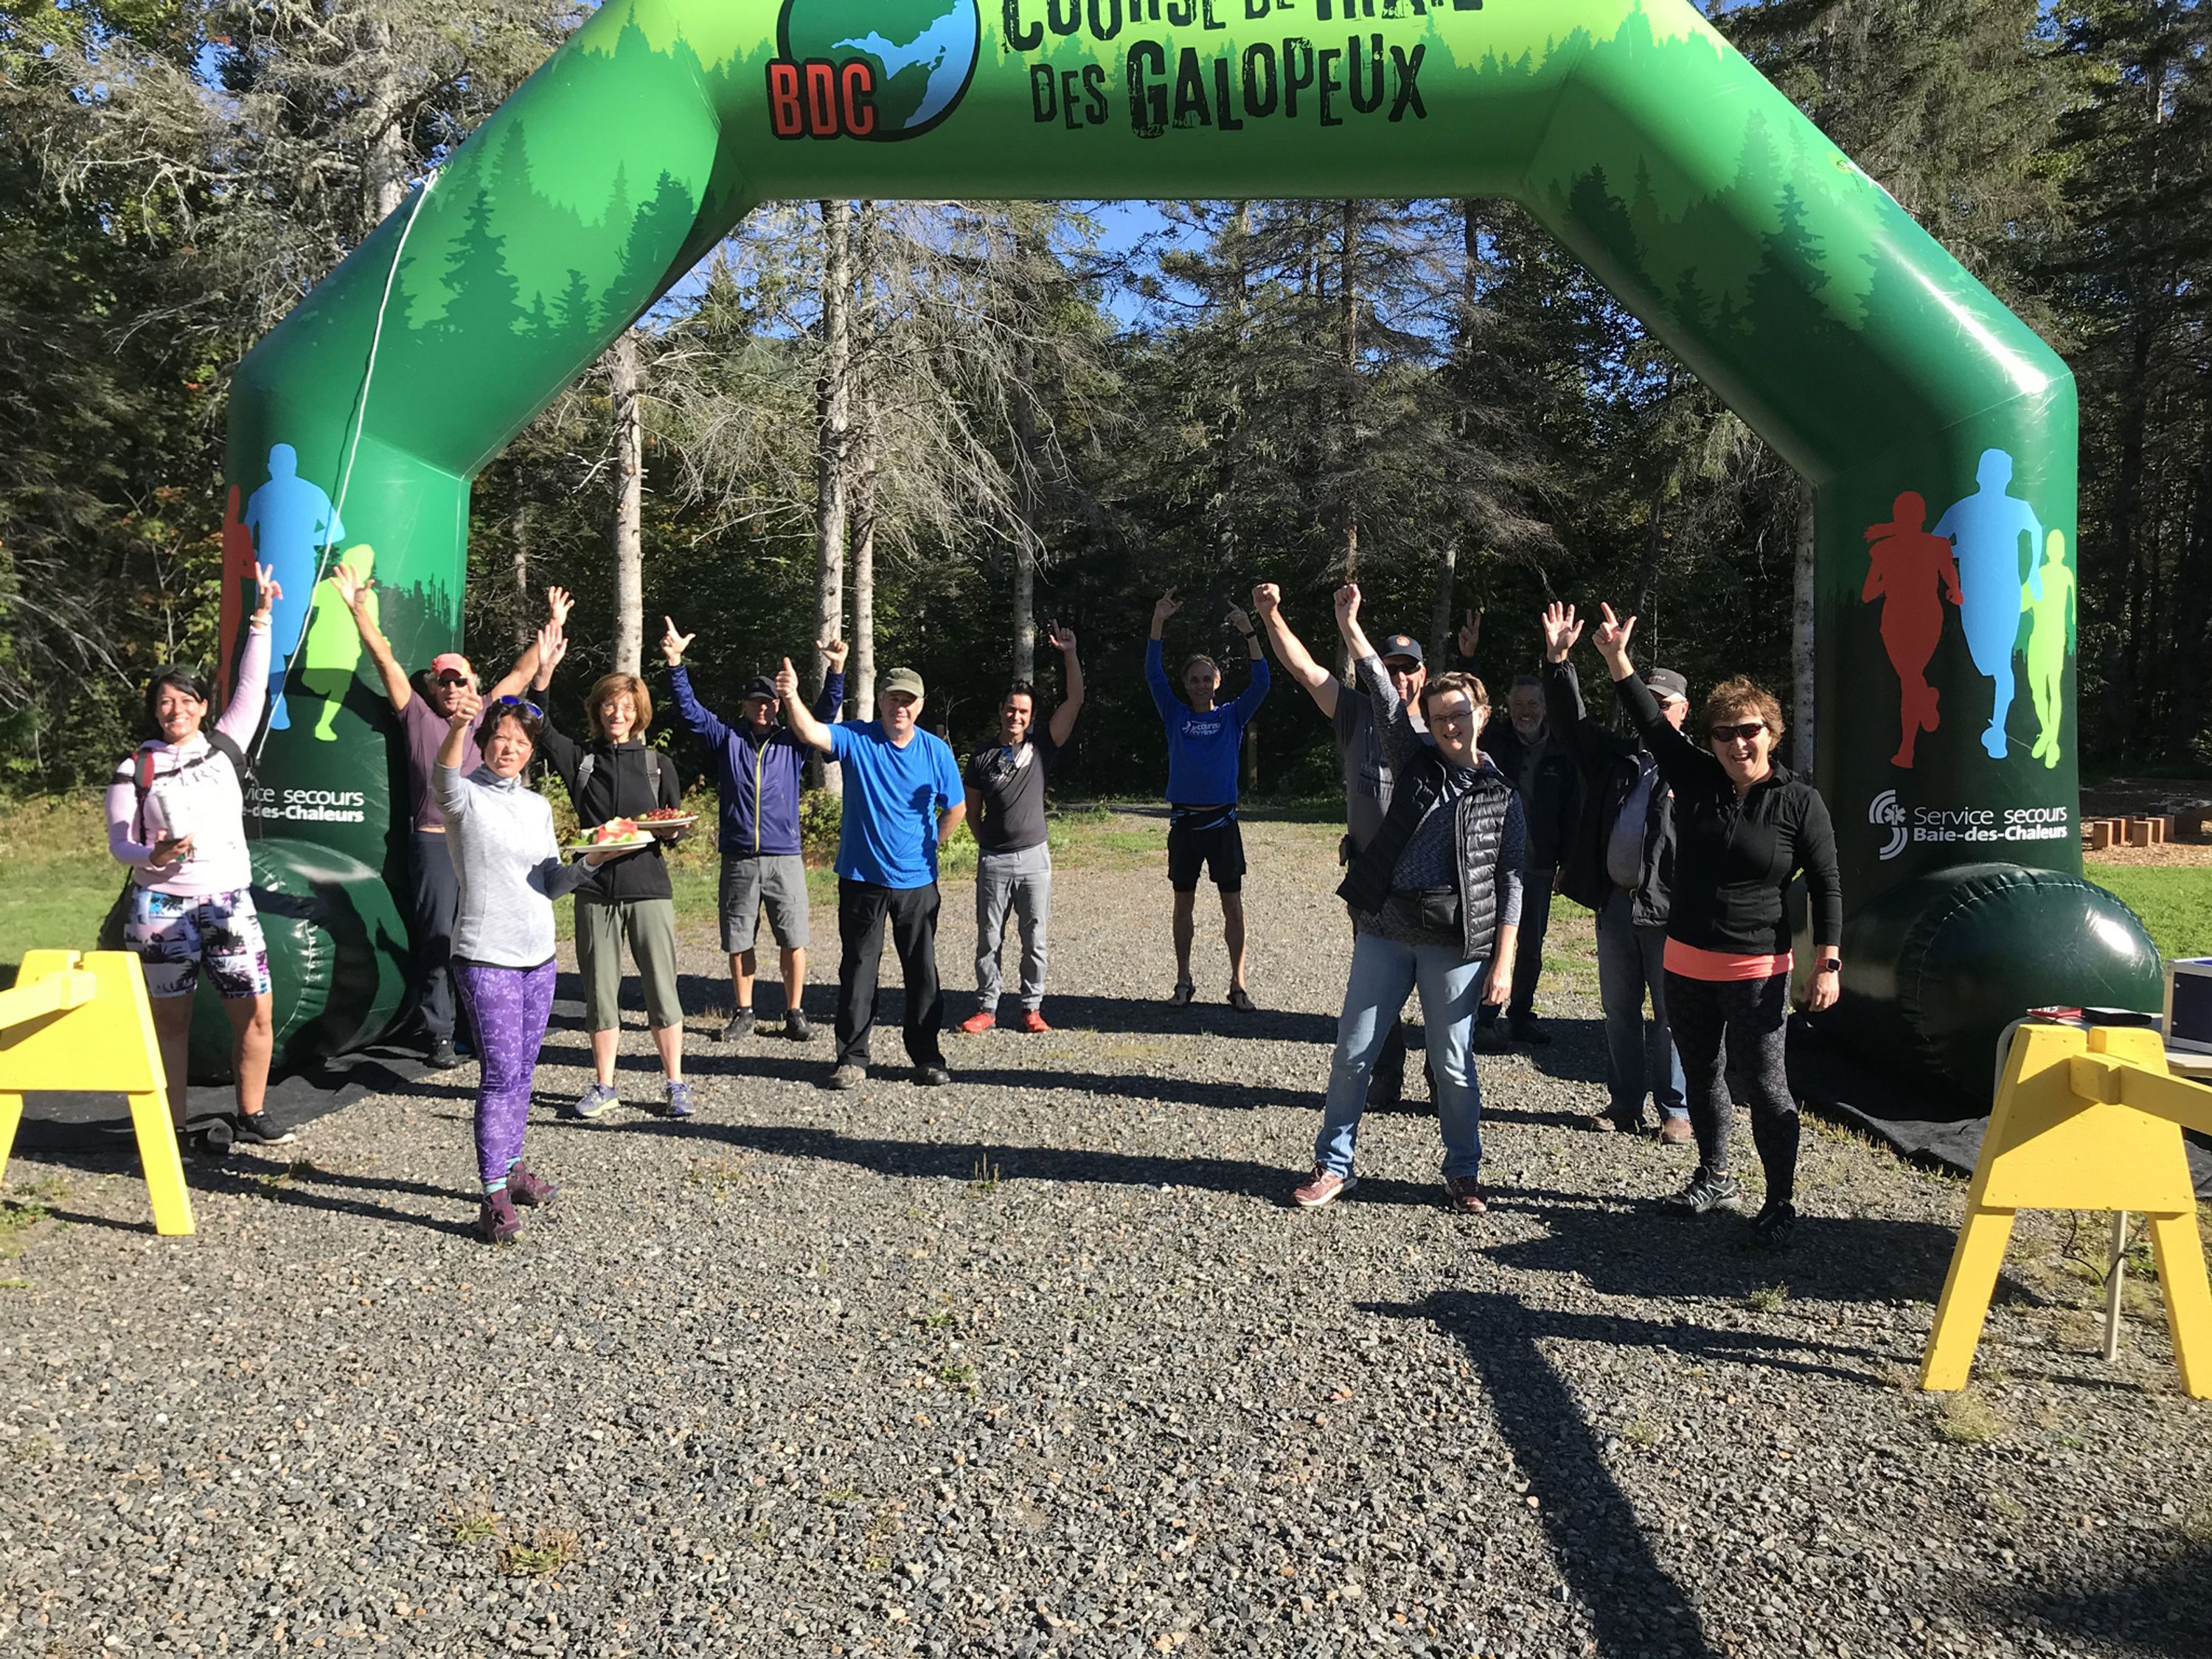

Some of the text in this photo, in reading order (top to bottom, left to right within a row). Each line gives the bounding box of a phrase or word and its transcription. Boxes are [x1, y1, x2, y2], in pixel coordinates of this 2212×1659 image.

[1030, 34, 1427, 139] DES GALOPEUX
[769, 62, 875, 136] BDC
[244, 783, 365, 807] vice secours
[243, 805, 365, 823] -des-Chaleurs
[1913, 806, 2068, 824] Service secours
[1913, 824, 2067, 841] Baie-des-Chaleurs
